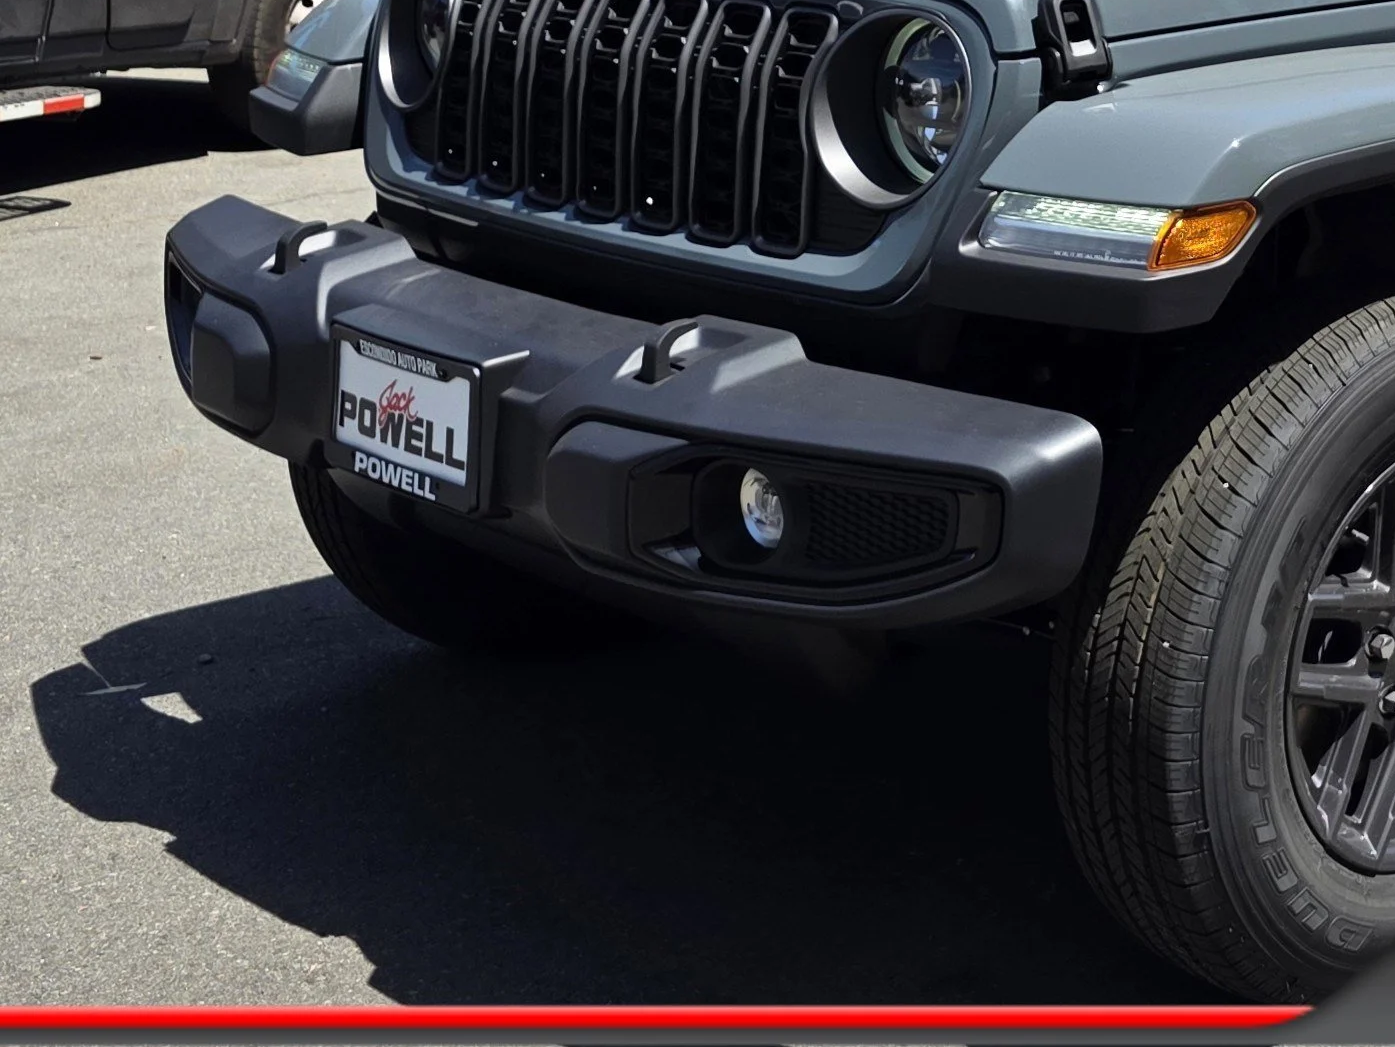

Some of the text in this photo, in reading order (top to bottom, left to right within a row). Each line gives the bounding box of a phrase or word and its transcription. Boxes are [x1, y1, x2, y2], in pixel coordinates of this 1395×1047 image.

[398, 352, 417, 372] AUTO
[417, 356, 439, 378] PARK
[378, 378, 419, 429] Jack
[338, 388, 466, 472] POWELL
[353, 450, 437, 502] POWELL
